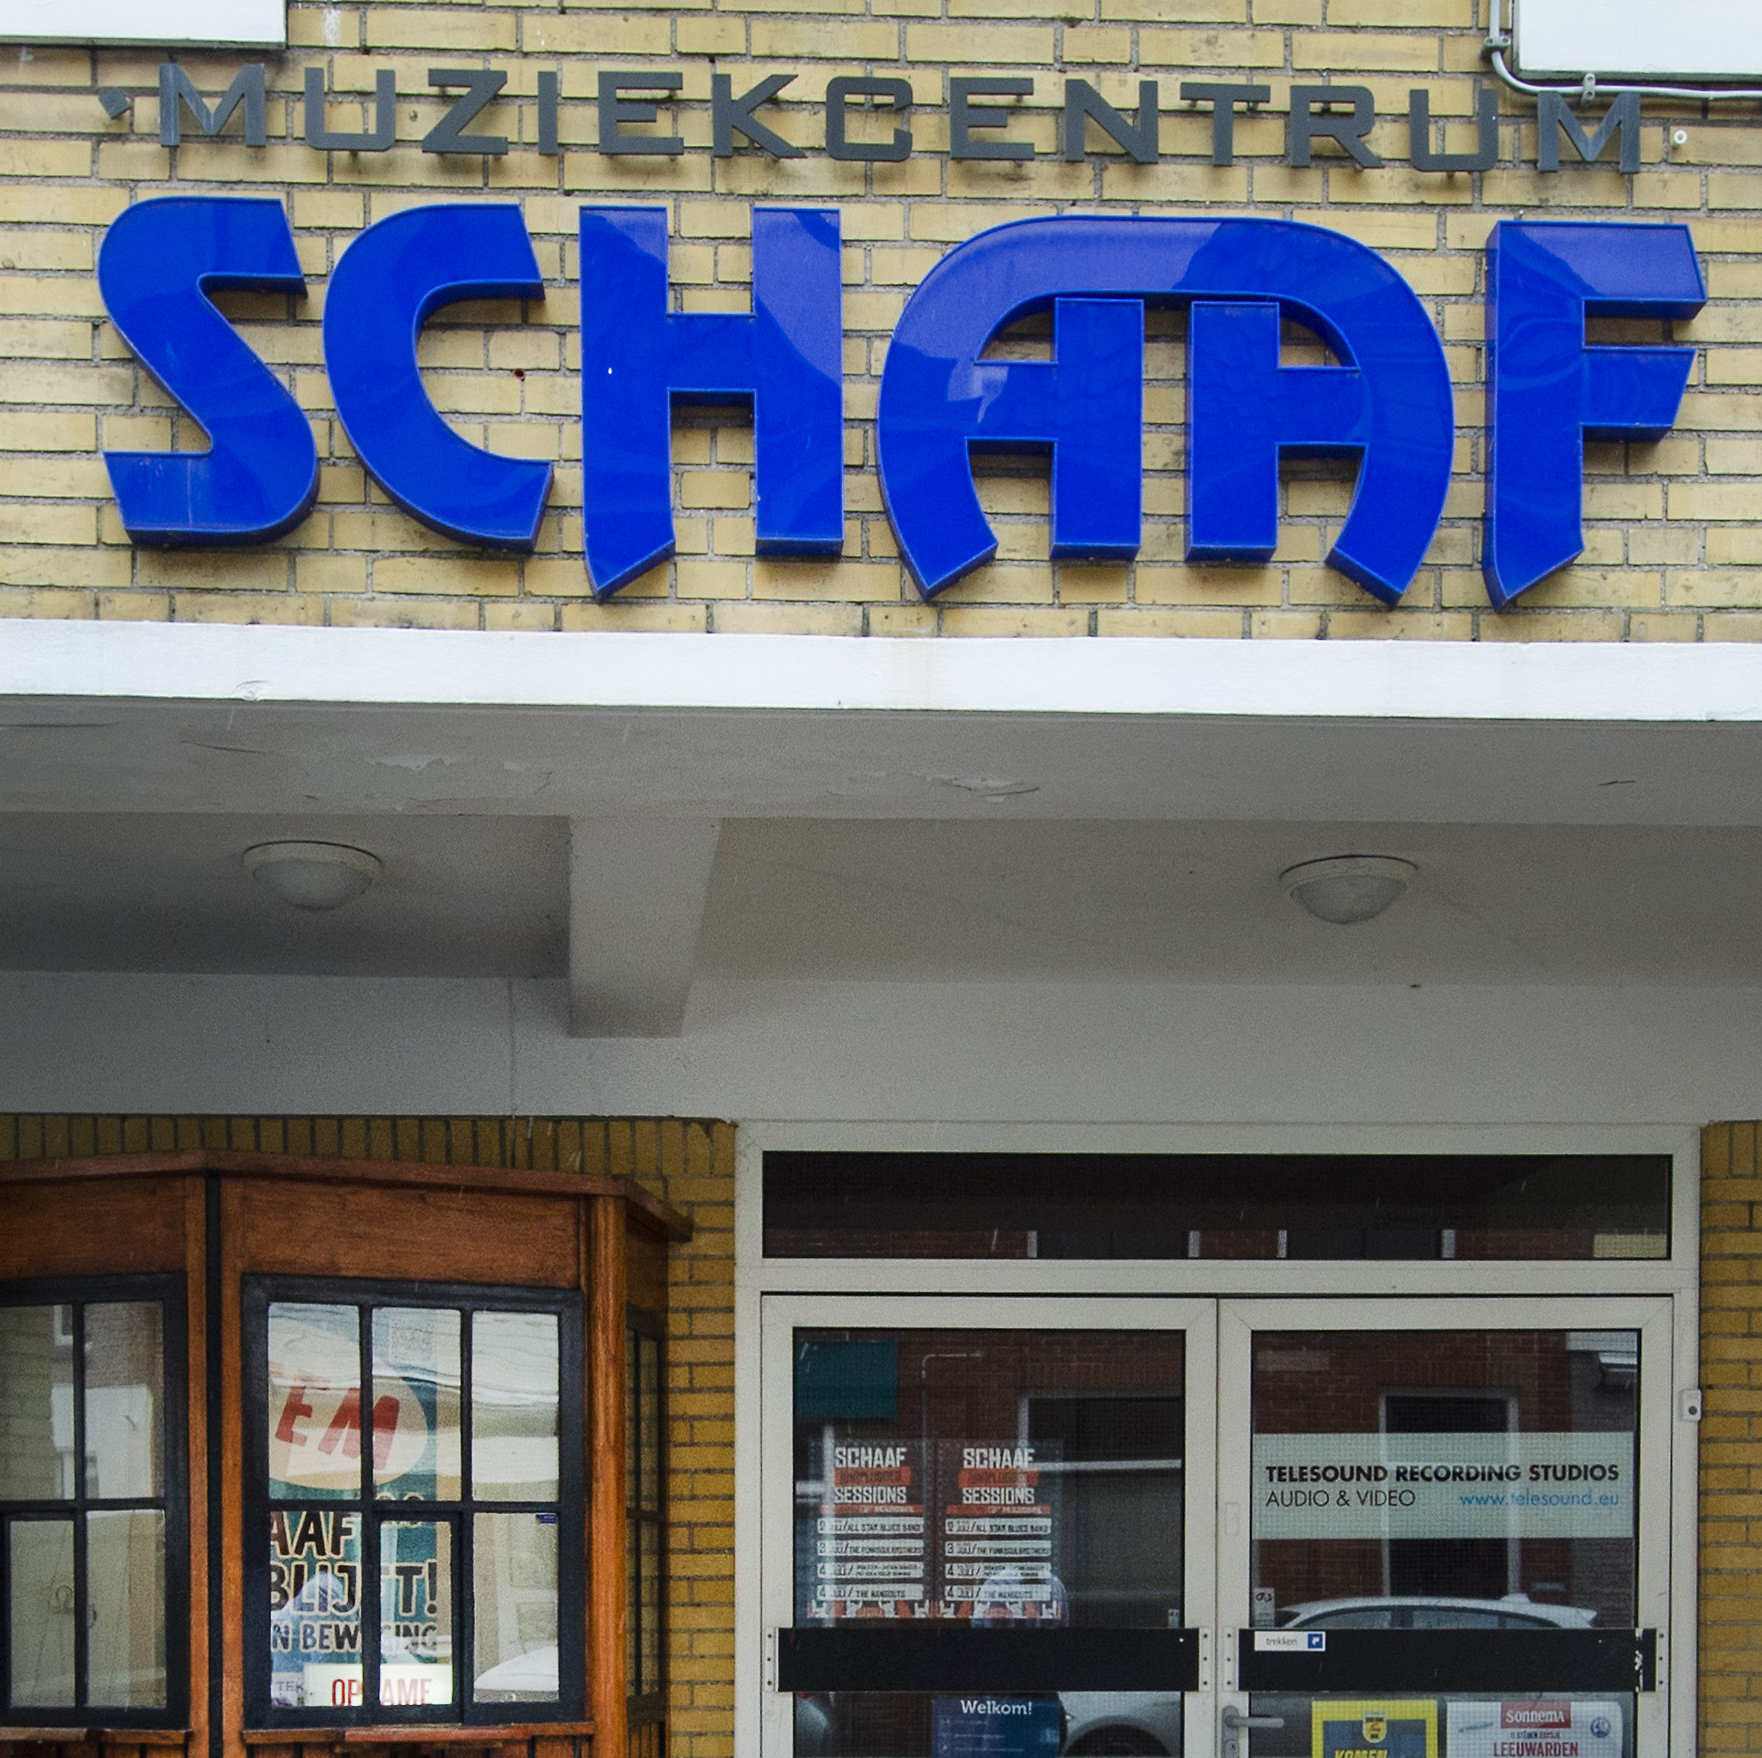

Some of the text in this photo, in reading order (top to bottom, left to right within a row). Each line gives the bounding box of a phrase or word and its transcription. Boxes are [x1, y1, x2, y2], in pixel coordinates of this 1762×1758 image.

[158, 62, 1642, 174] MUZIEKCENTRUM
[98, 194, 1708, 611] SCHAAF
[835, 1446, 908, 1468] SCHAAF
[962, 1447, 1036, 1469] SCHAAF
[1266, 1464, 1620, 1482] TELESOUND RECORDING STUDIOS
[834, 1486, 907, 1504] SESSIONS
[962, 1487, 1035, 1504] SESSIONS
[1266, 1488, 1620, 1507] AUDIO & VIDEO www.telesound.eu
[271, 1560, 437, 1616] BLIJT!
[301, 1622, 436, 1653] BEWING
[1265, 1636, 1298, 1646] trekken
[332, 1678, 432, 1706] OPAME
[960, 1699, 1033, 1716] Welkom!
[1493, 1742, 1579, 1757] LEEUWARDEN
